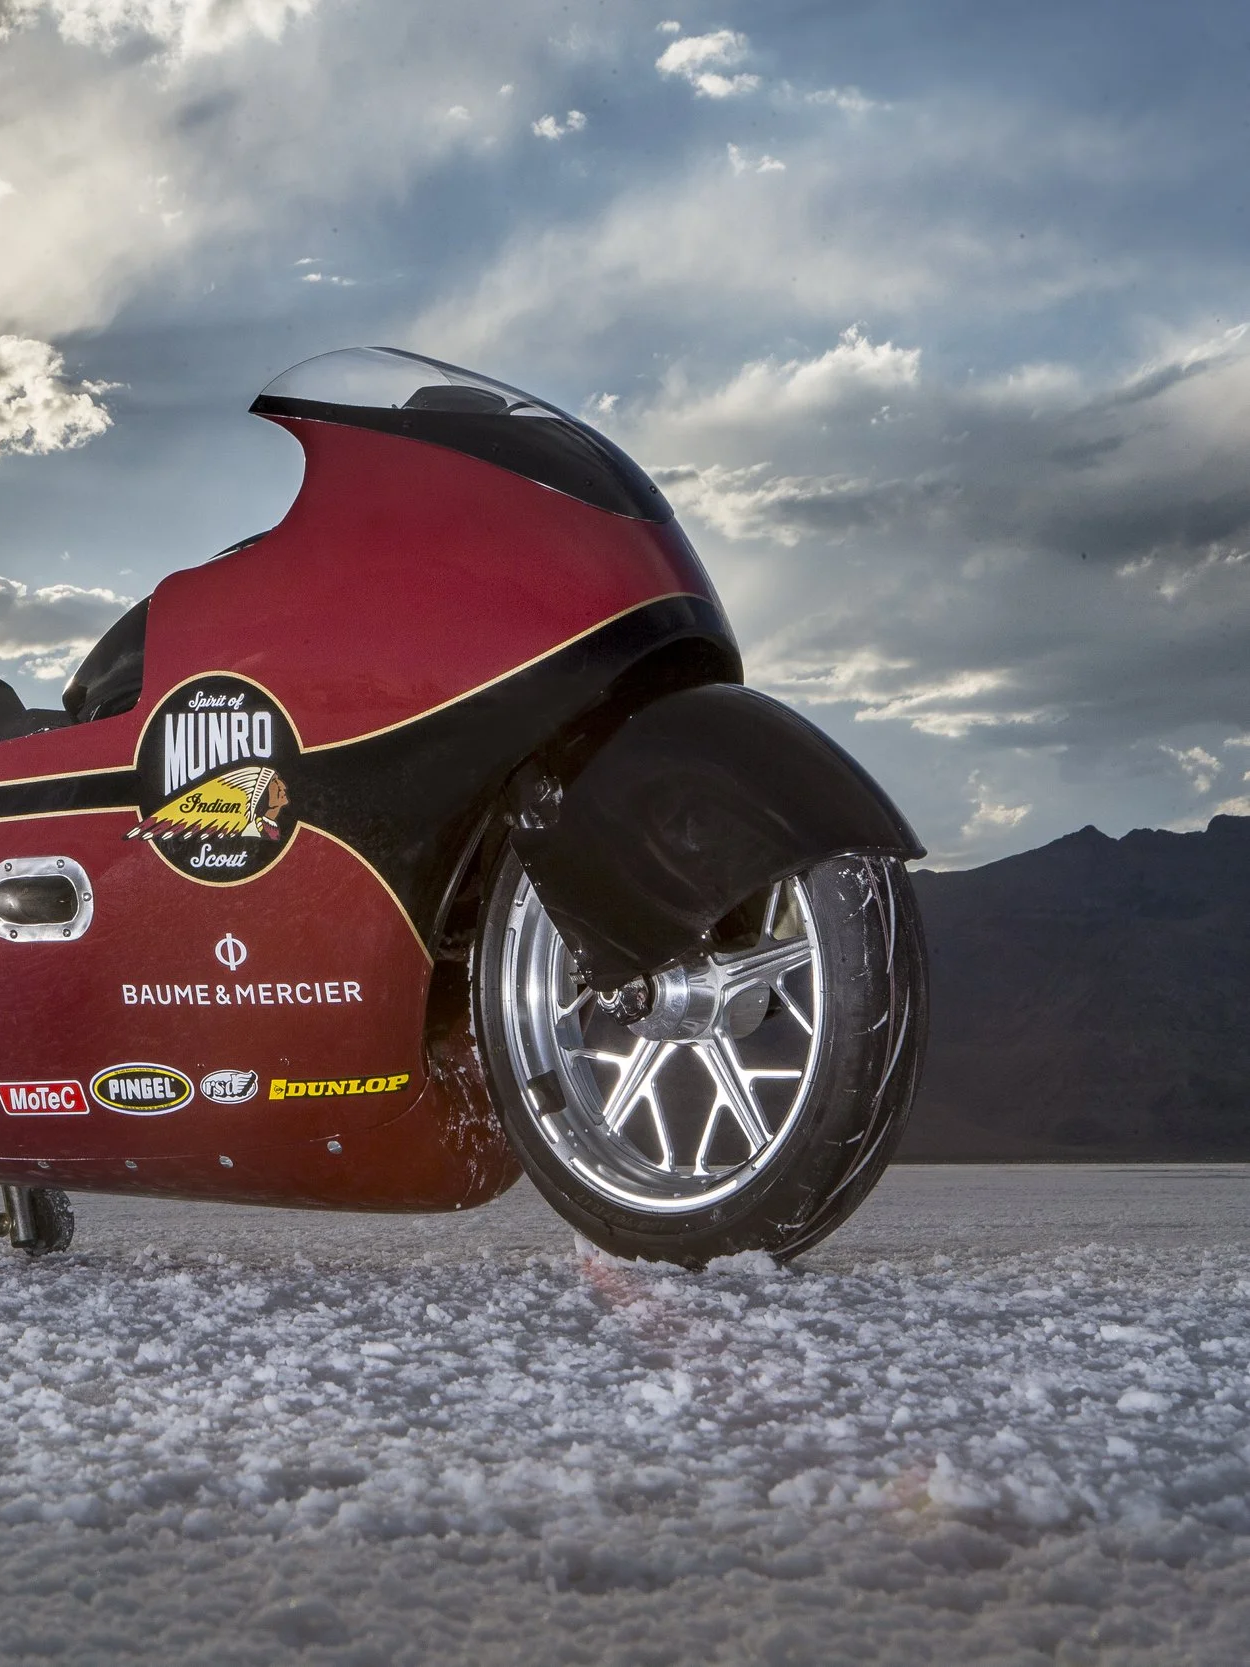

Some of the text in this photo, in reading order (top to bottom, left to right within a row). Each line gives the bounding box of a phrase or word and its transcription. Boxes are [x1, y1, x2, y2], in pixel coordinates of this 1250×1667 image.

[188, 691, 245, 711] Spirit of
[164, 711, 272, 797] MUNRO
[179, 792, 241, 814] Indian
[190, 843, 248, 868] Scout
[108, 1077, 176, 1100] PINGEL
[285, 1074, 410, 1097] DUNLOP
[9, 1086, 76, 1111] MoTeC
